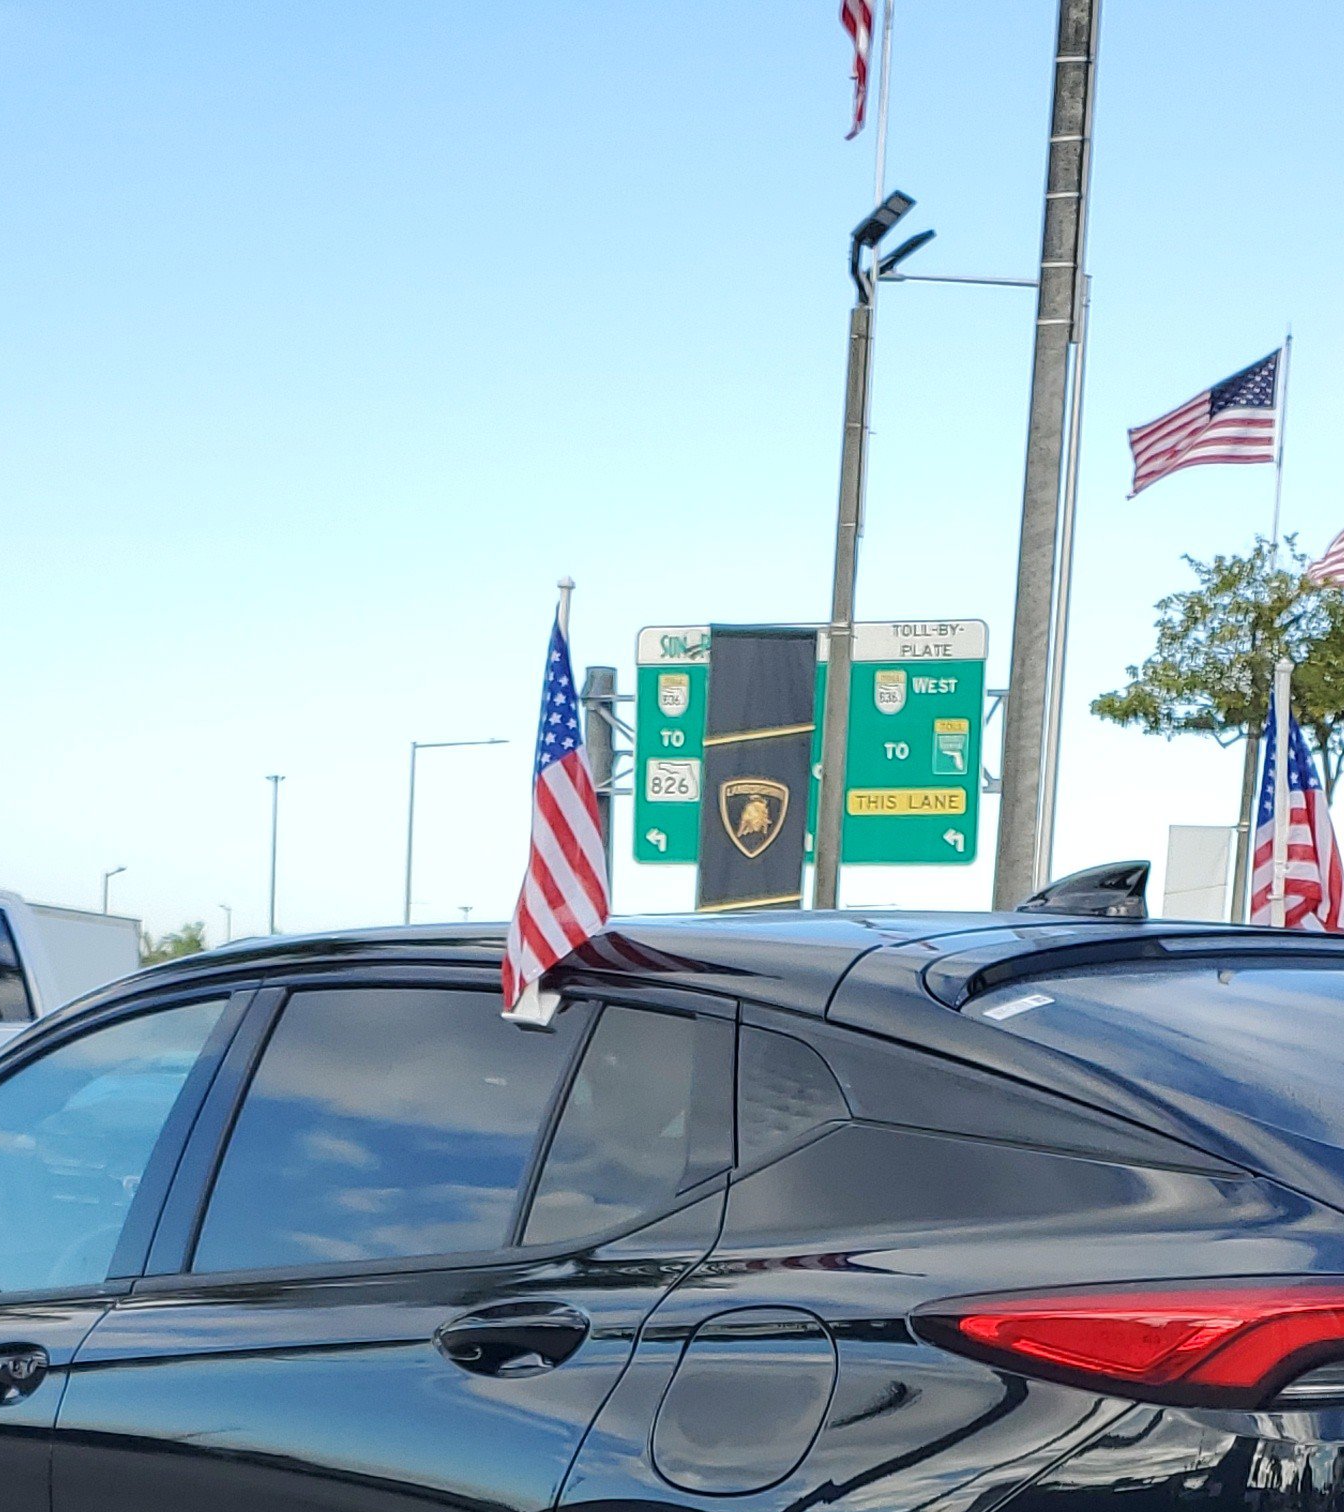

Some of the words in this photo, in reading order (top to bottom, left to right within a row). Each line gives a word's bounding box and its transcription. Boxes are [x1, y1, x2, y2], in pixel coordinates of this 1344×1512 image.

[892, 623, 965, 638] TOLL-BY-
[900, 643, 954, 658] PLATE
[912, 676, 959, 694] WEST
[659, 728, 685, 748] TO
[884, 741, 910, 760] TO
[651, 776, 690, 795] 826
[855, 794, 897, 810] THIS
[908, 794, 961, 810] LANE
